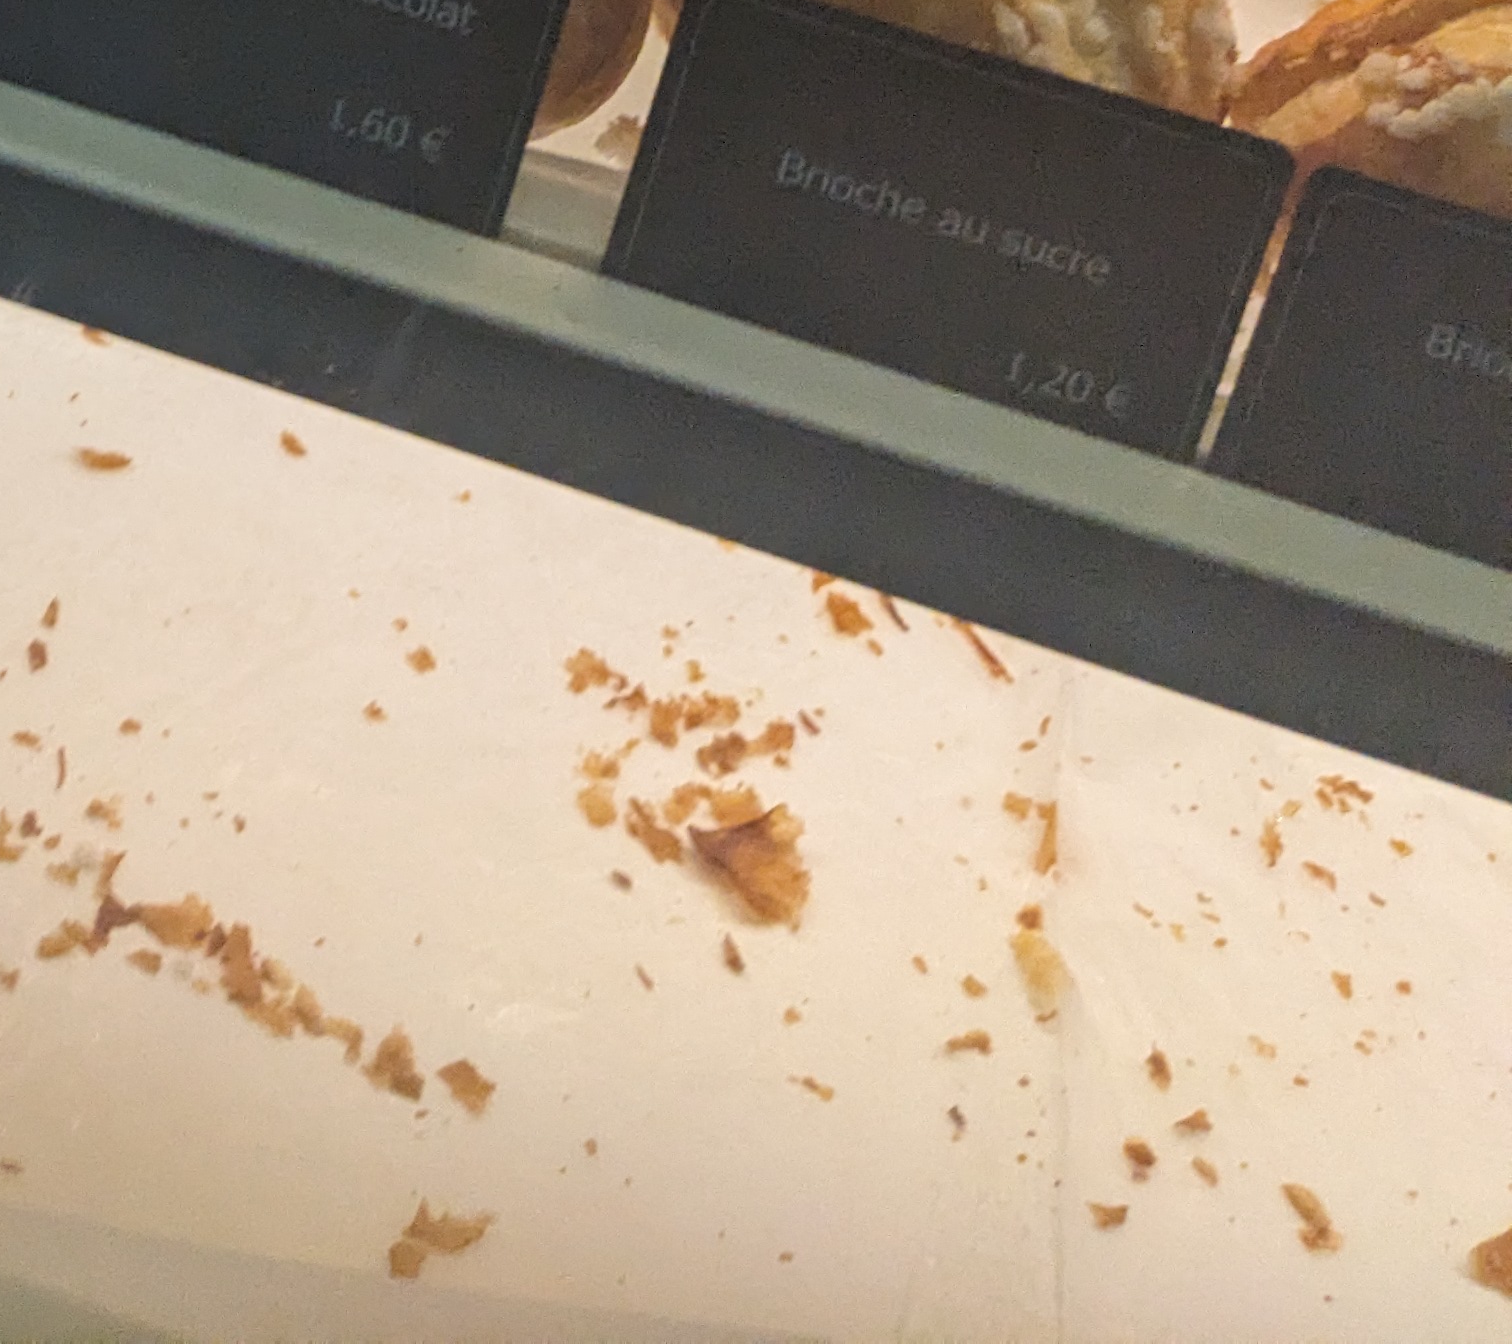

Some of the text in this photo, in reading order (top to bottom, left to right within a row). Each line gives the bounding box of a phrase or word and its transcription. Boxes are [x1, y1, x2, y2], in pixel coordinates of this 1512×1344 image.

[330, 97, 452, 166] 1,60 €
[774, 146, 1113, 287] Brioche au sucre
[1005, 350, 1134, 420] 1,20 €
[1425, 322, 1512, 384] Brio
